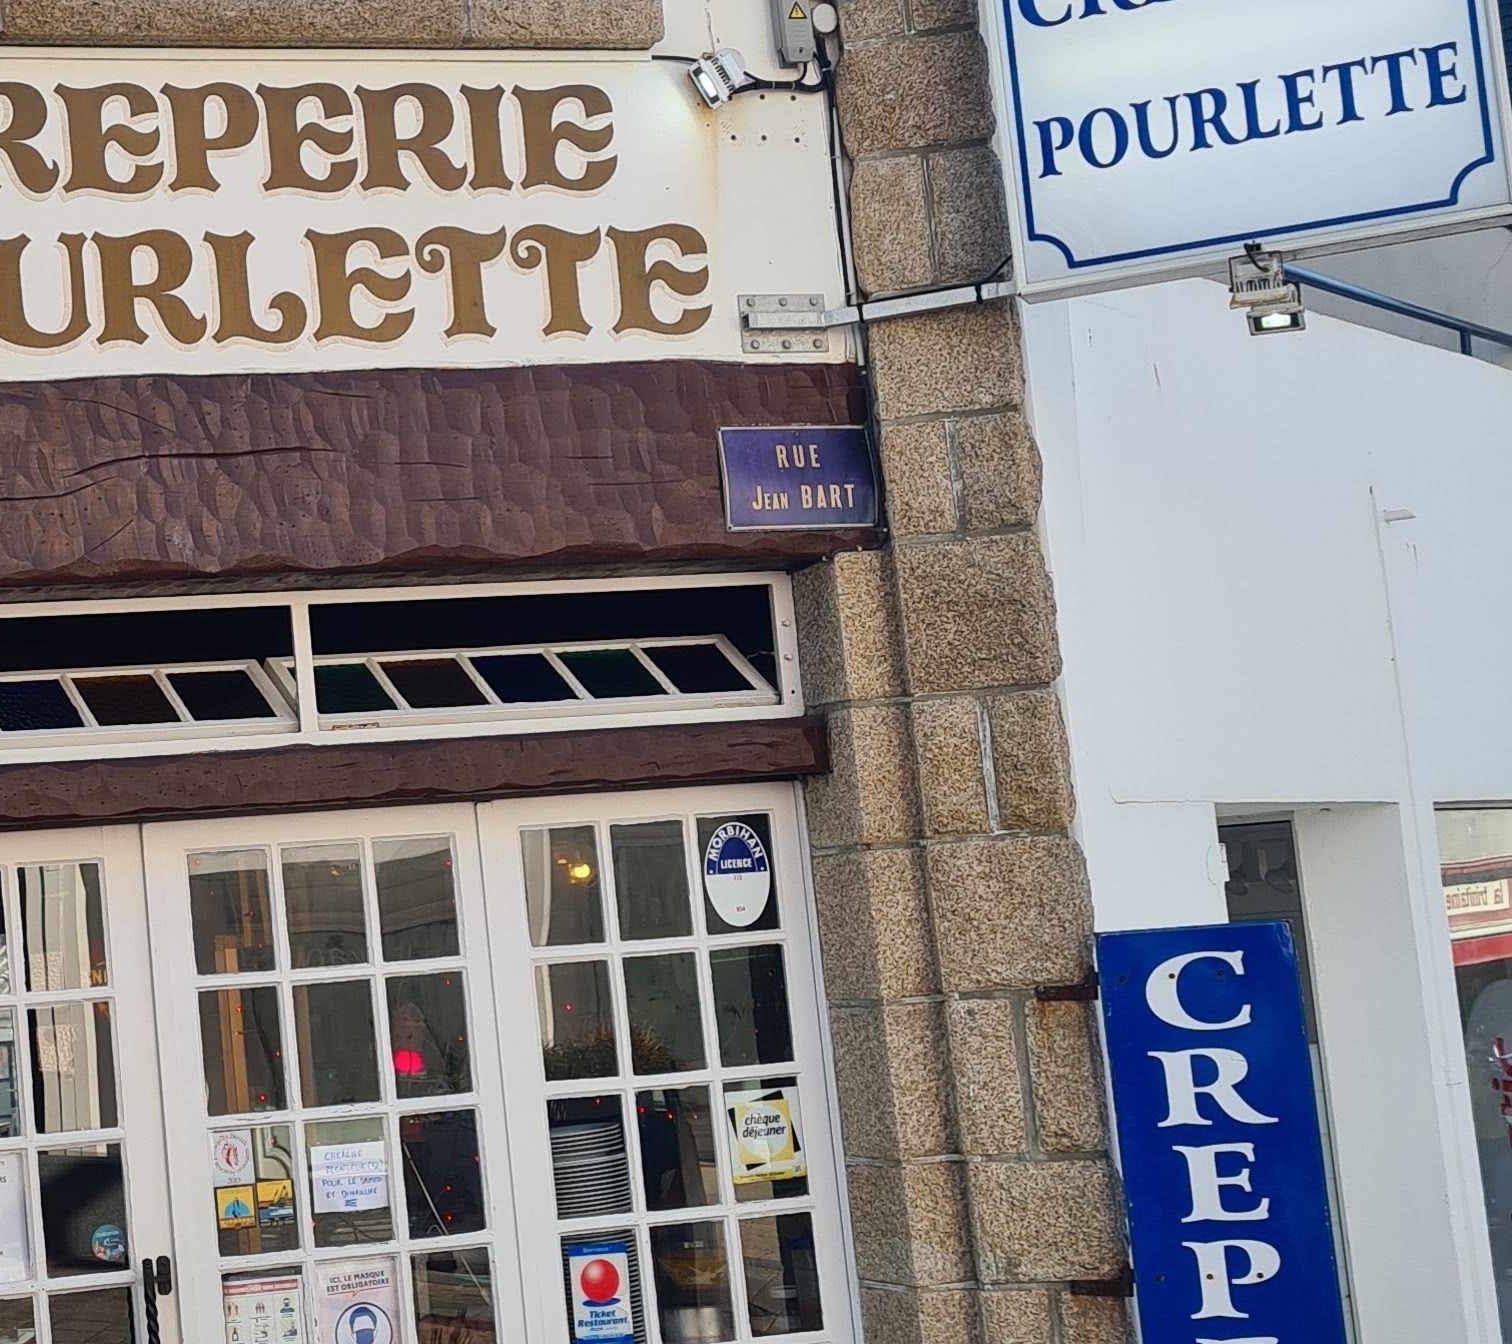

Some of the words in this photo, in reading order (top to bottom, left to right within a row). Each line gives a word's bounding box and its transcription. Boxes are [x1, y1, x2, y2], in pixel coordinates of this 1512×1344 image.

[1033, 41, 1467, 179] POURLETTE
[775, 444, 821, 469] RUE
[800, 483, 856, 510] BART
[708, 825, 764, 862] MORBIHAN
[720, 857, 753, 870] LICENCE
[744, 1112, 781, 1127] chèque
[742, 1125, 787, 1140] déjeuner
[343, 1274, 352, 1282] LE
[353, 1270, 385, 1280] MASQUE
[326, 1284, 340, 1293] EST
[340, 1277, 390, 1291] OBLIGATOIRE
[589, 1309, 617, 1319] Ticket
[577, 1316, 628, 1328] Restaurant
